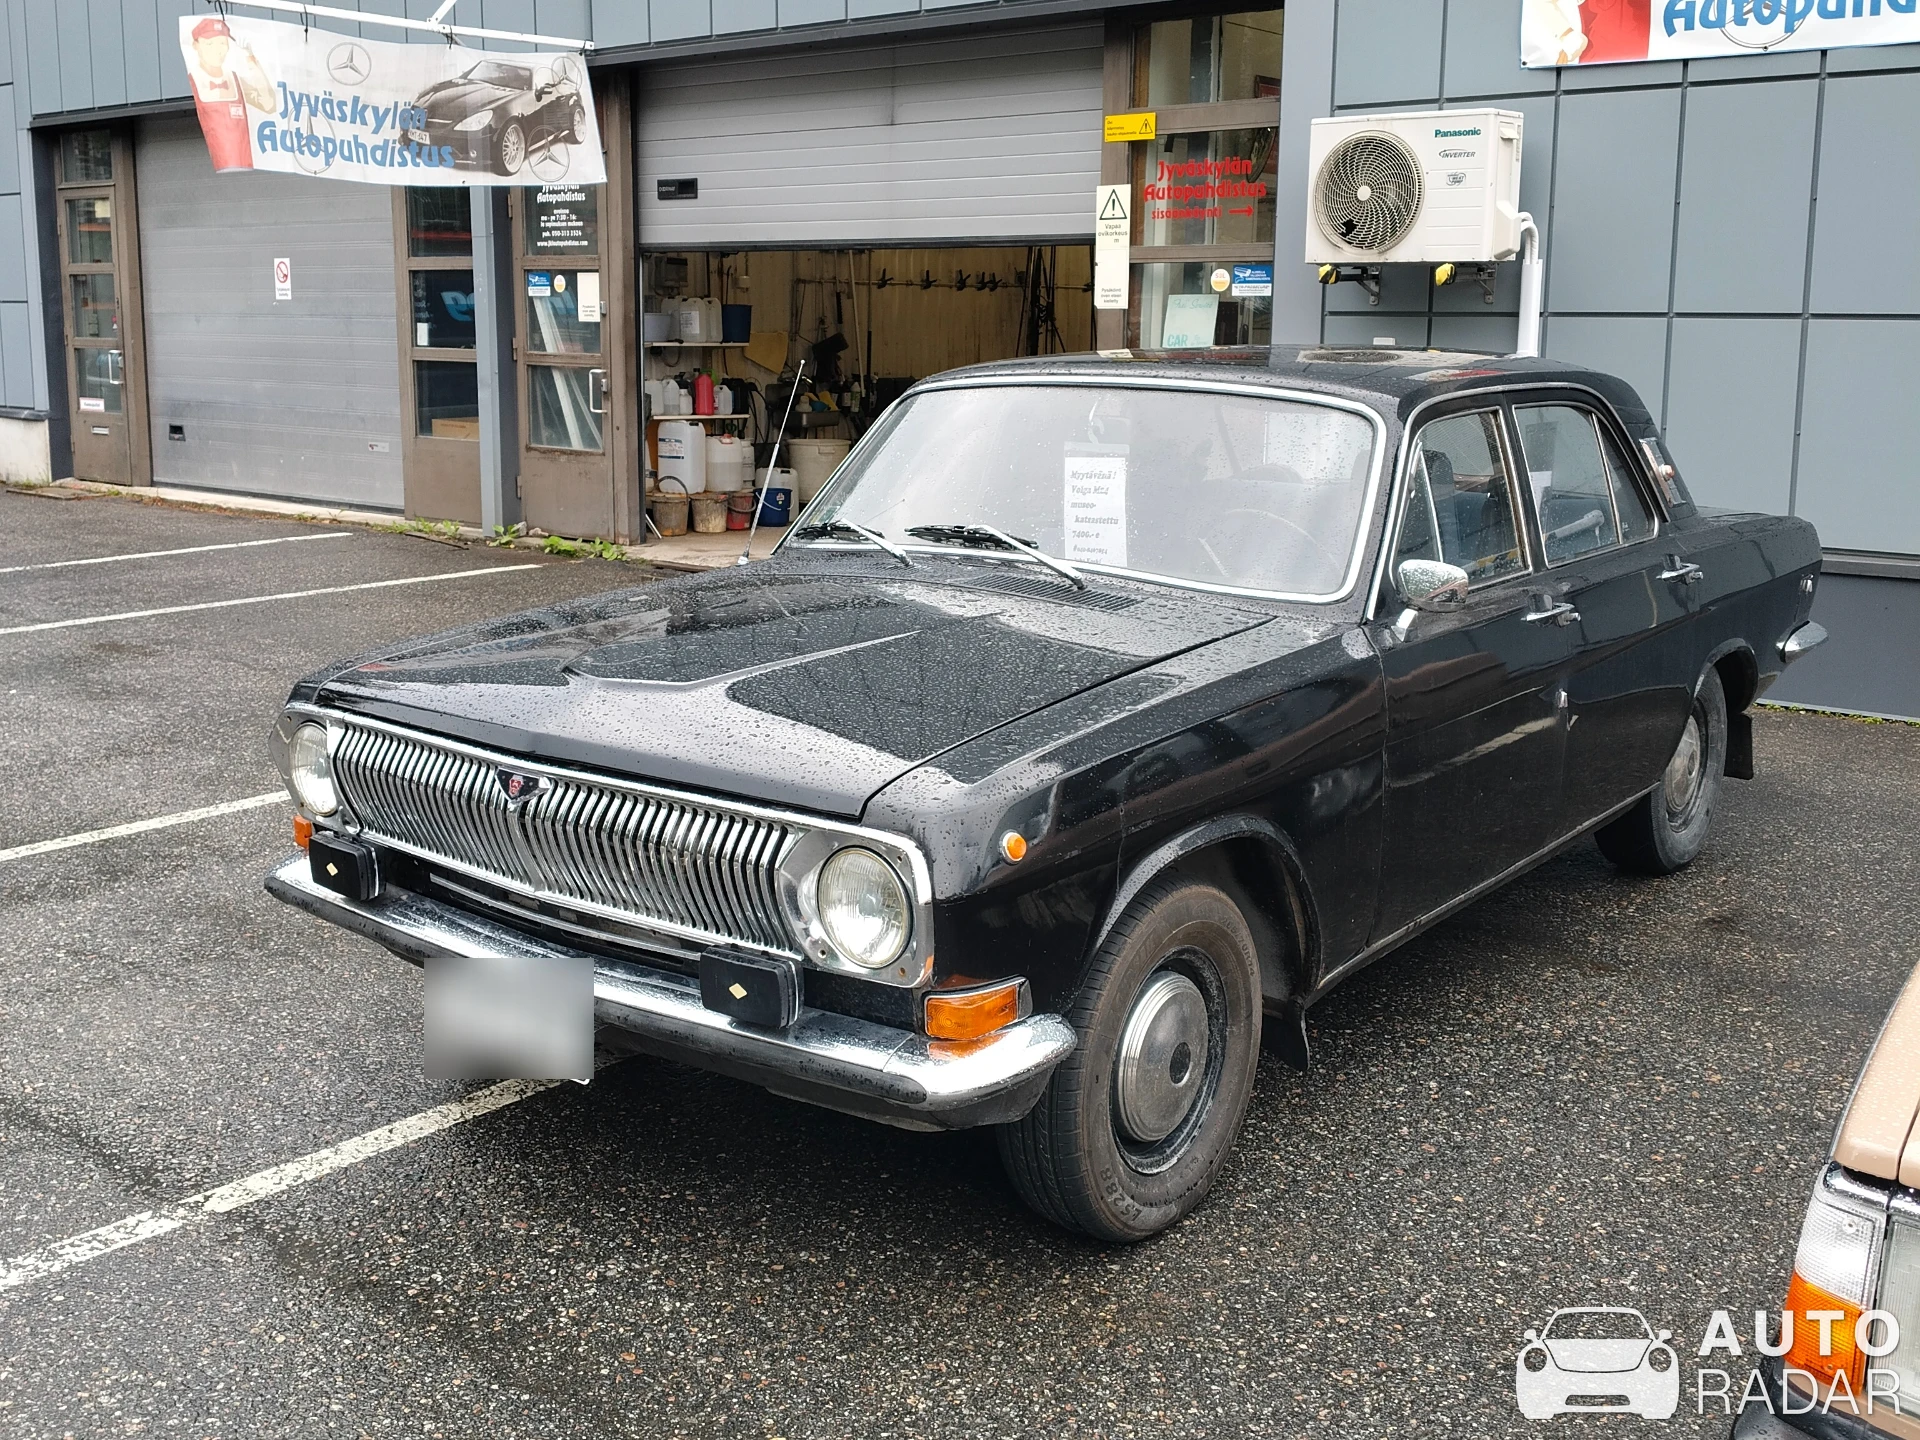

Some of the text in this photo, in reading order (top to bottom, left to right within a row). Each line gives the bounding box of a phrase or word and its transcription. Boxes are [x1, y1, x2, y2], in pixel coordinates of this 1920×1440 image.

[277, 81, 427, 134] Jyväskylän
[257, 120, 455, 168] Autopuhdistus
[1434, 127, 1482, 138] Panasonic
[1157, 156, 1252, 182] Jyväskylän
[1143, 179, 1267, 204] Autopuhdistus
[1167, 334, 1188, 347] CAR
[1100, 1167, 1142, 1222] LS288
